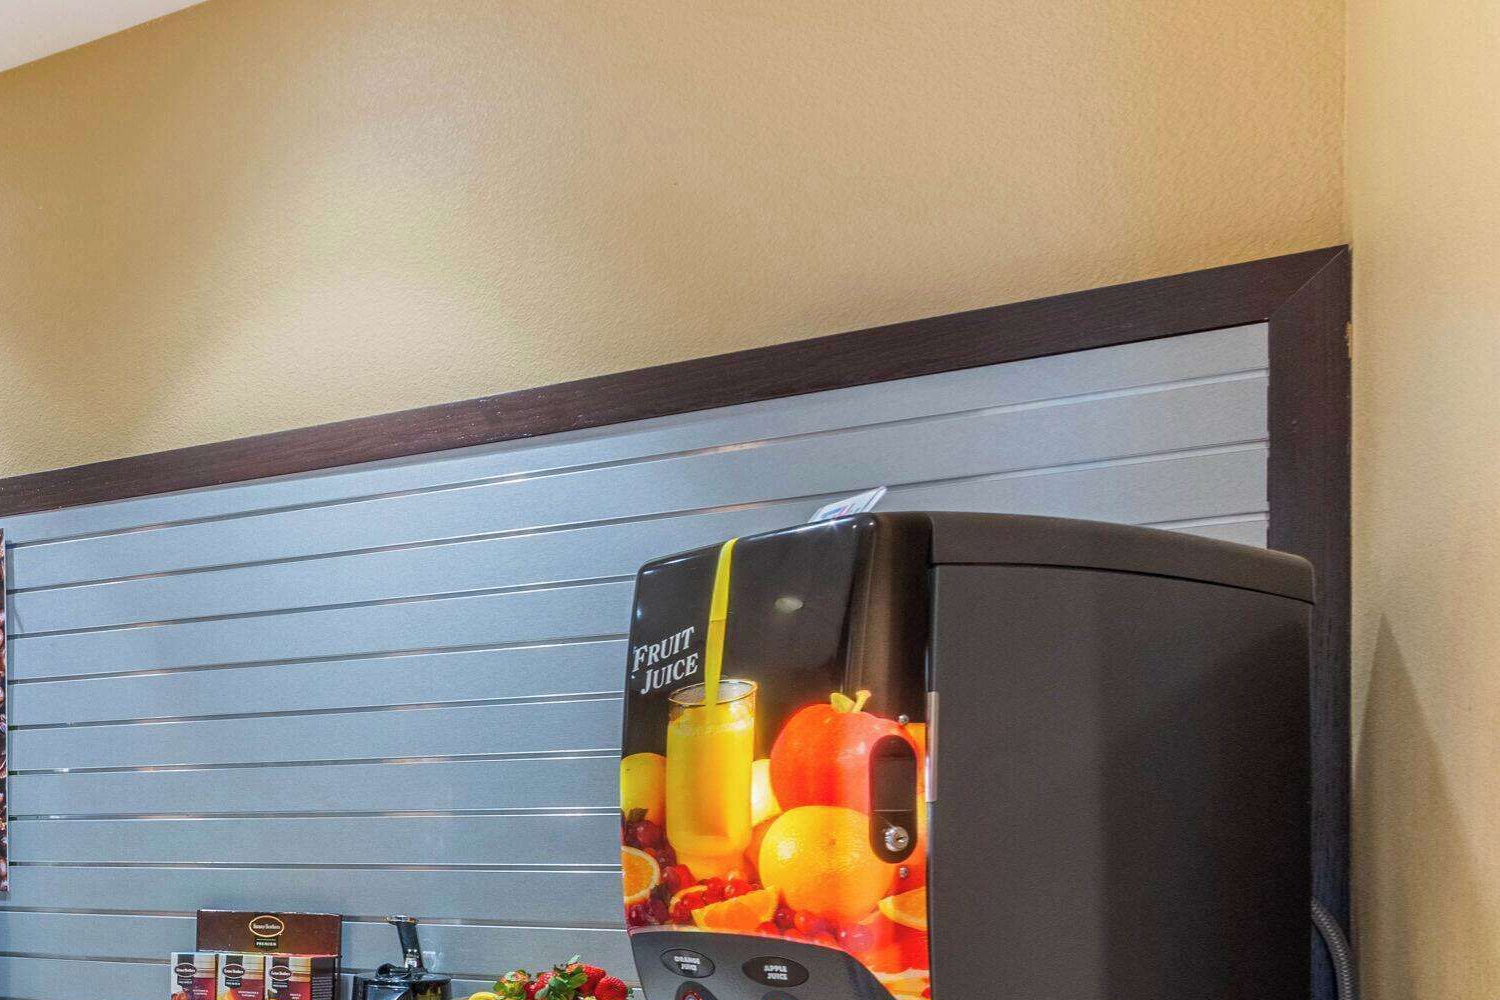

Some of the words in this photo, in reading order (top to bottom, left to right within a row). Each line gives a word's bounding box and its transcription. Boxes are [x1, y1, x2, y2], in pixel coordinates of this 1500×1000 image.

[631, 626, 695, 673] FRUIT
[640, 652, 699, 695] JUICE
[673, 955, 701, 965] ORANGE
[680, 963, 698, 971] JUICE
[763, 965, 788, 973] APPLE
[767, 972, 789, 981] JUICE
